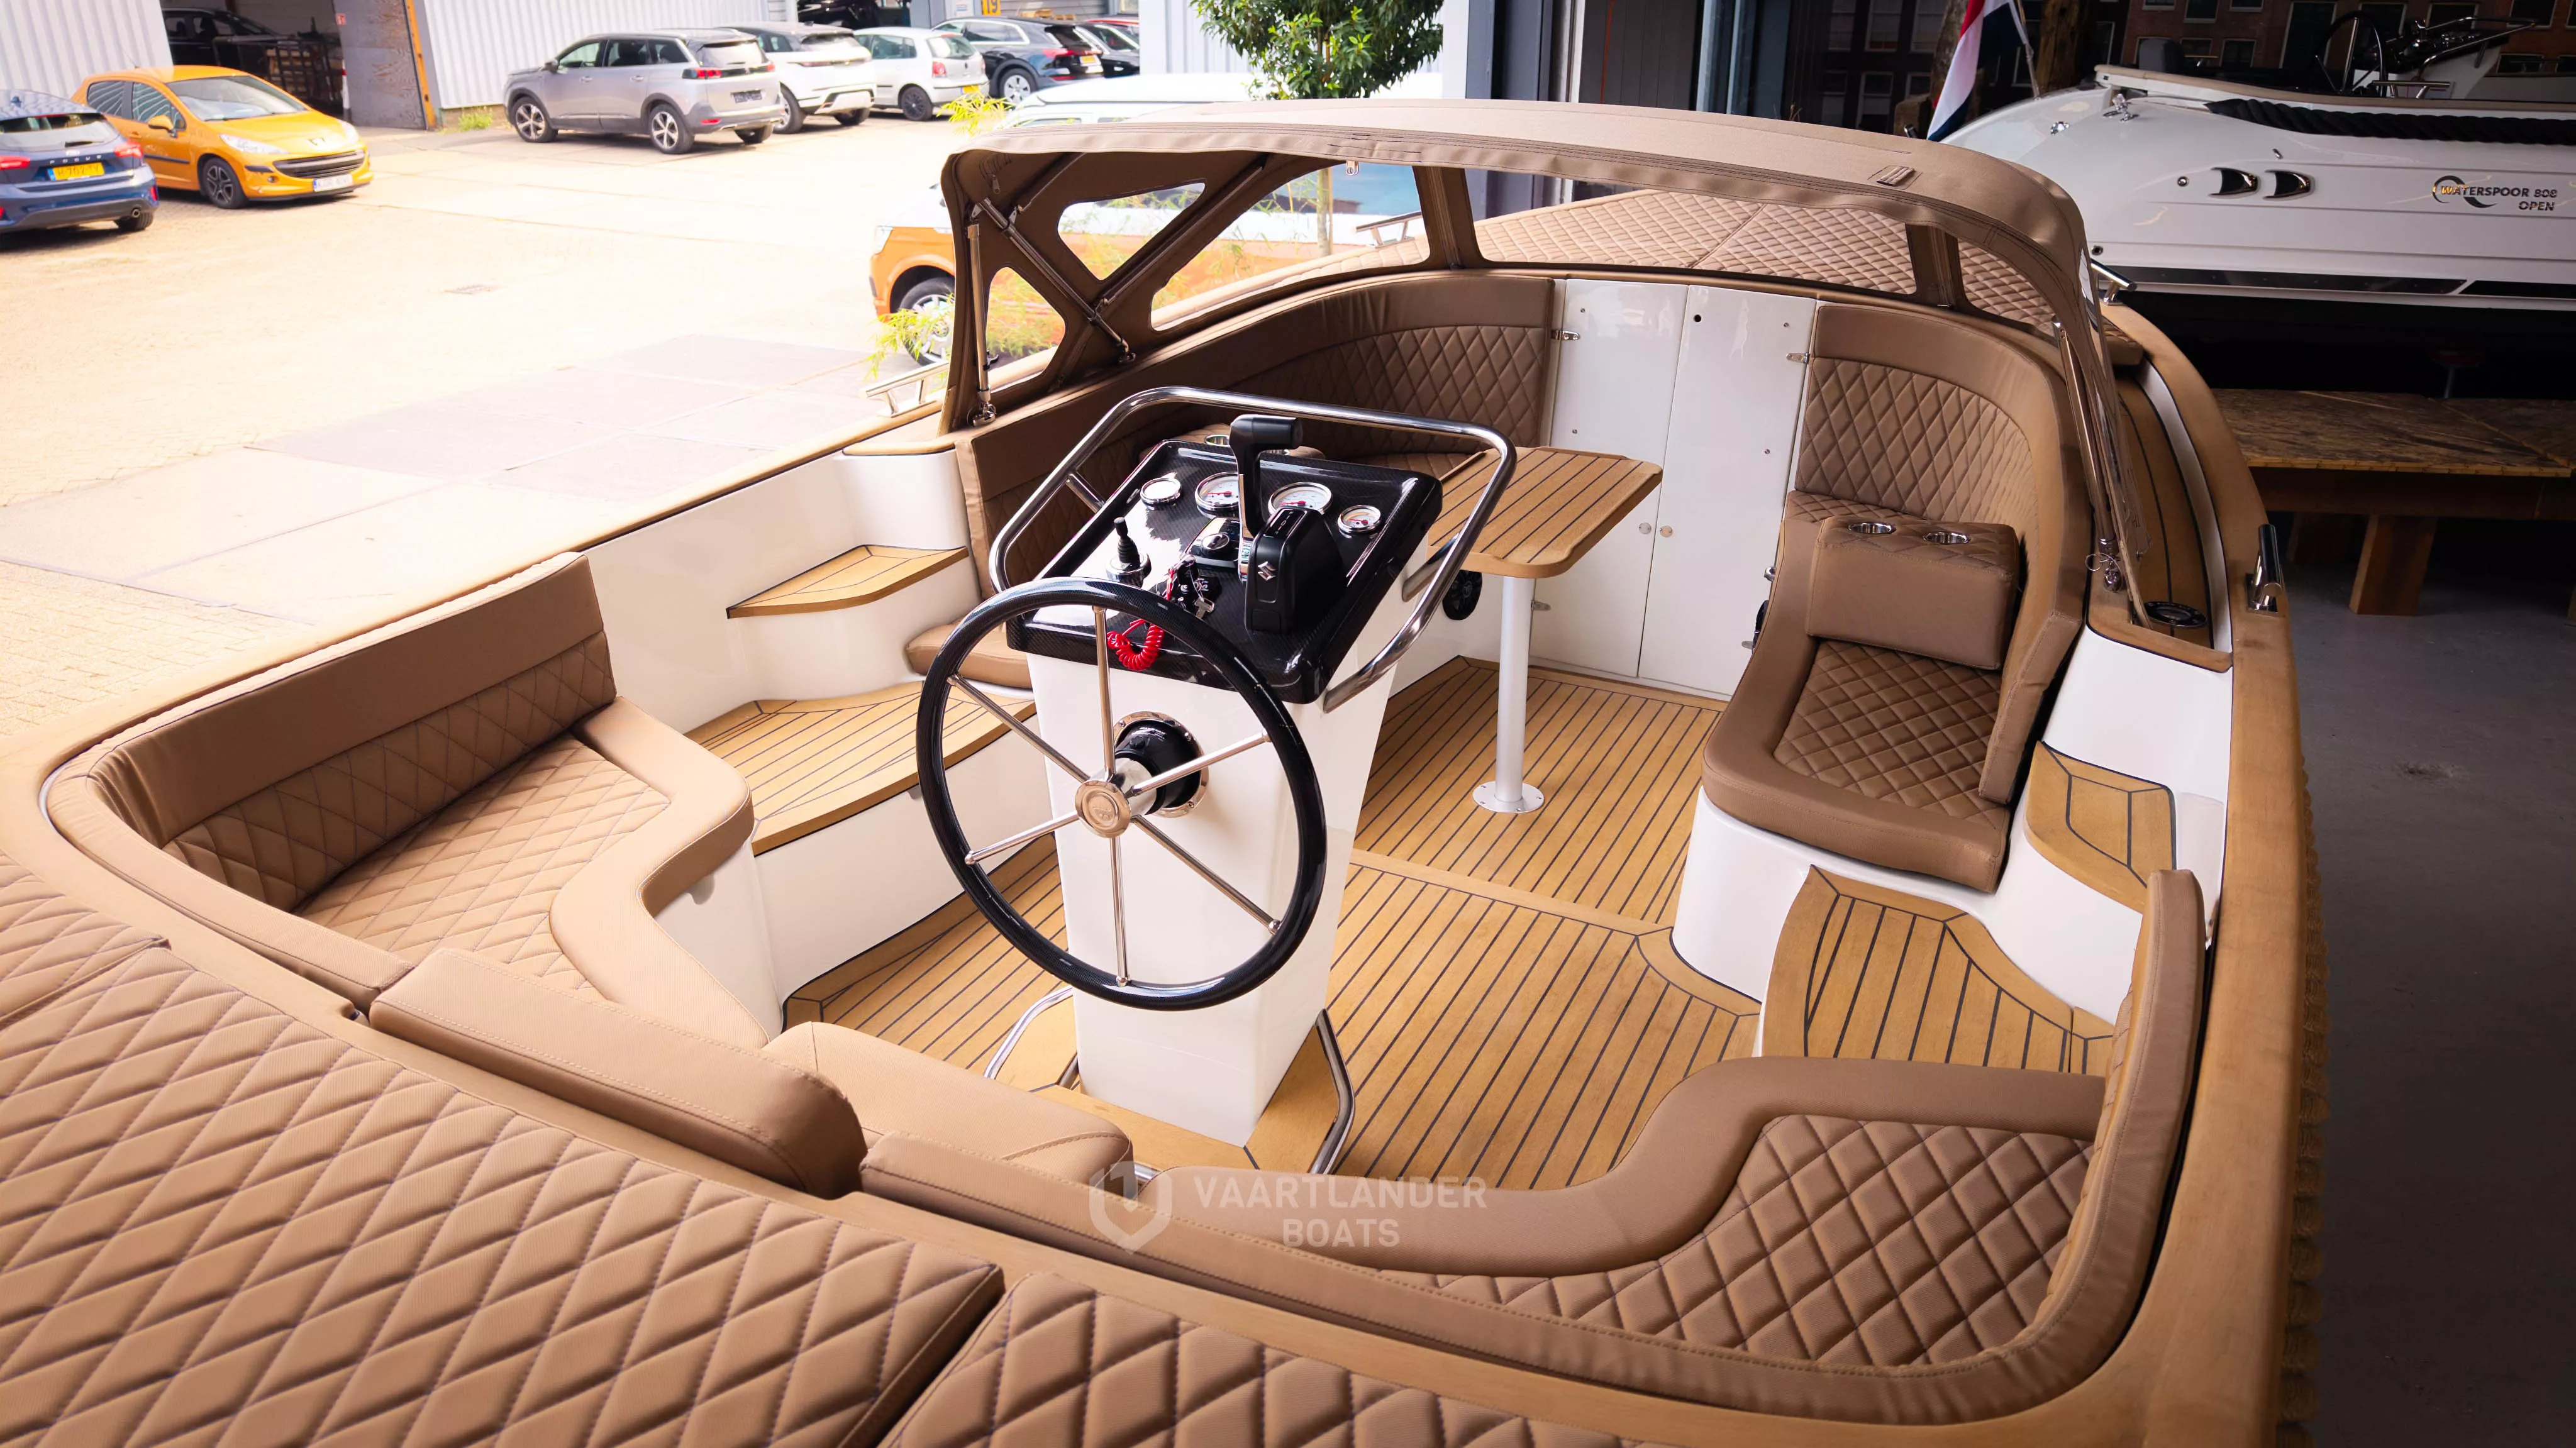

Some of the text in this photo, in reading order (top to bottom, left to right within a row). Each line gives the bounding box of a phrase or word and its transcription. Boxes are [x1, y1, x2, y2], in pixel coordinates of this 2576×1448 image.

[2441, 186, 2558, 198] WATERSPOOR 808
[2519, 201, 2555, 211] OPEN
